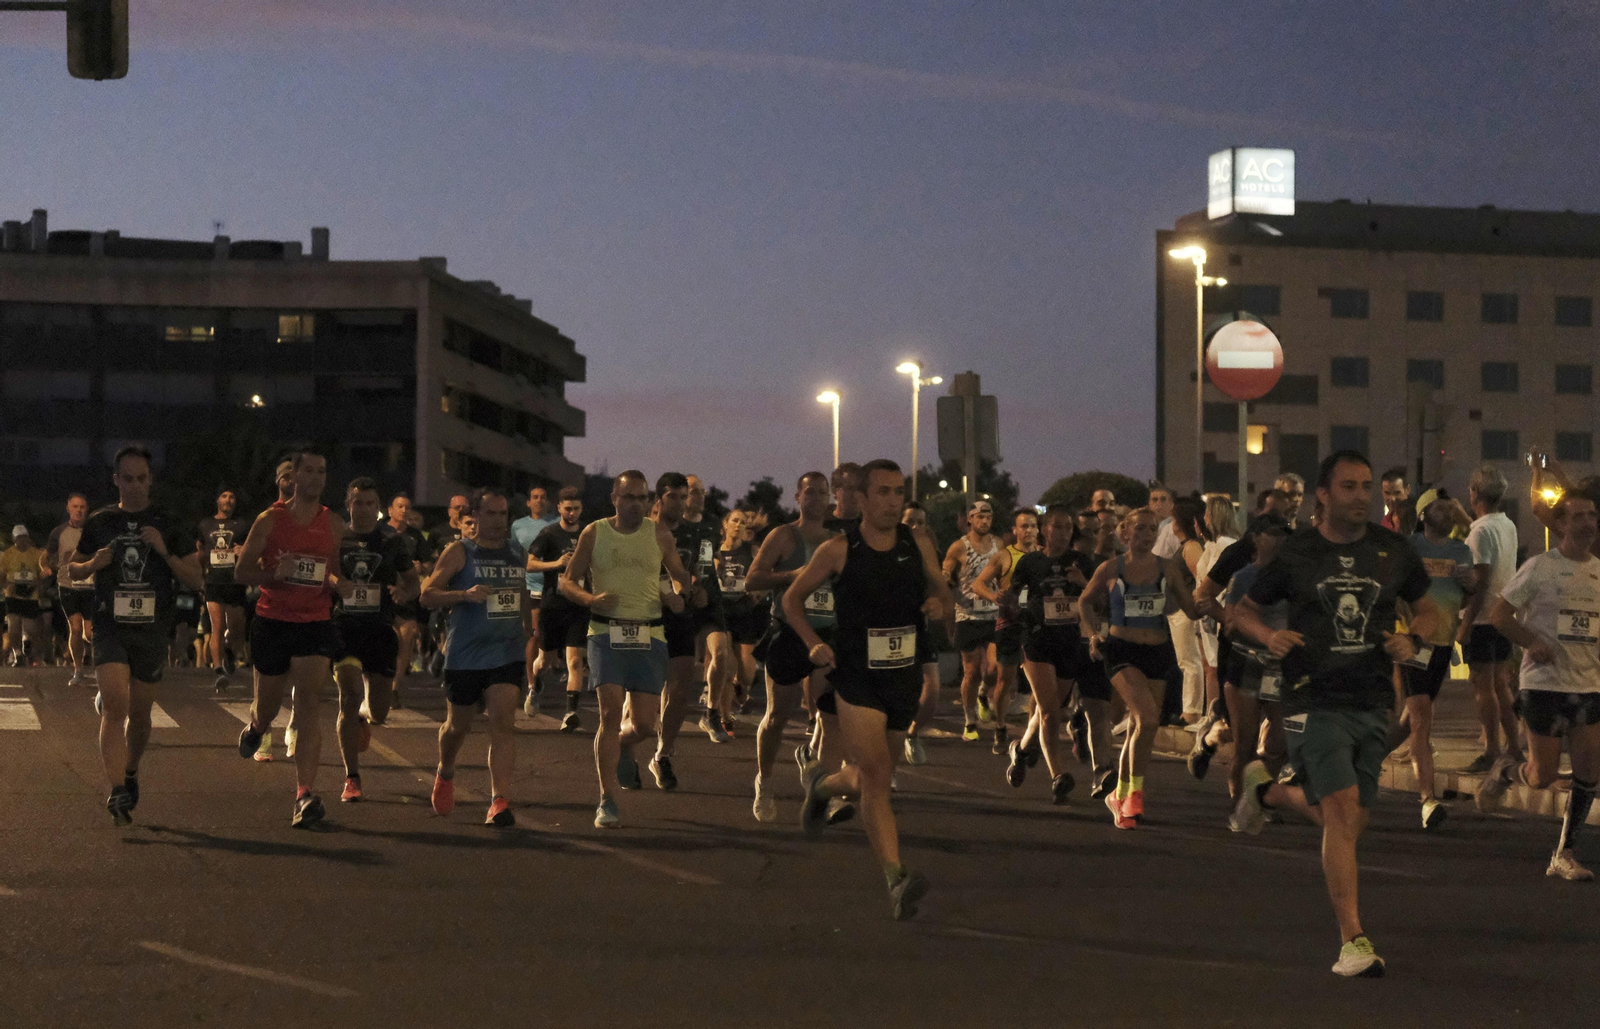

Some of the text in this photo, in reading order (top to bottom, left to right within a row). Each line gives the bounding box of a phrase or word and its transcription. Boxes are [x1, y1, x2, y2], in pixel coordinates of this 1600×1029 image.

[1212, 158, 1230, 186] AC
[1242, 157, 1285, 183] AC
[1240, 182, 1285, 193] HOTELS
[299, 561, 315, 573] 613
[475, 566, 497, 578] AVE
[355, 590, 367, 600] 83
[498, 594, 514, 605] 568
[814, 591, 828, 604] 910
[129, 598, 143, 609] 49
[1055, 602, 1070, 613] 974
[1138, 600, 1153, 610] 773
[1571, 616, 1589, 628] 243
[622, 626, 639, 636] 567
[888, 637, 902, 650] 57
